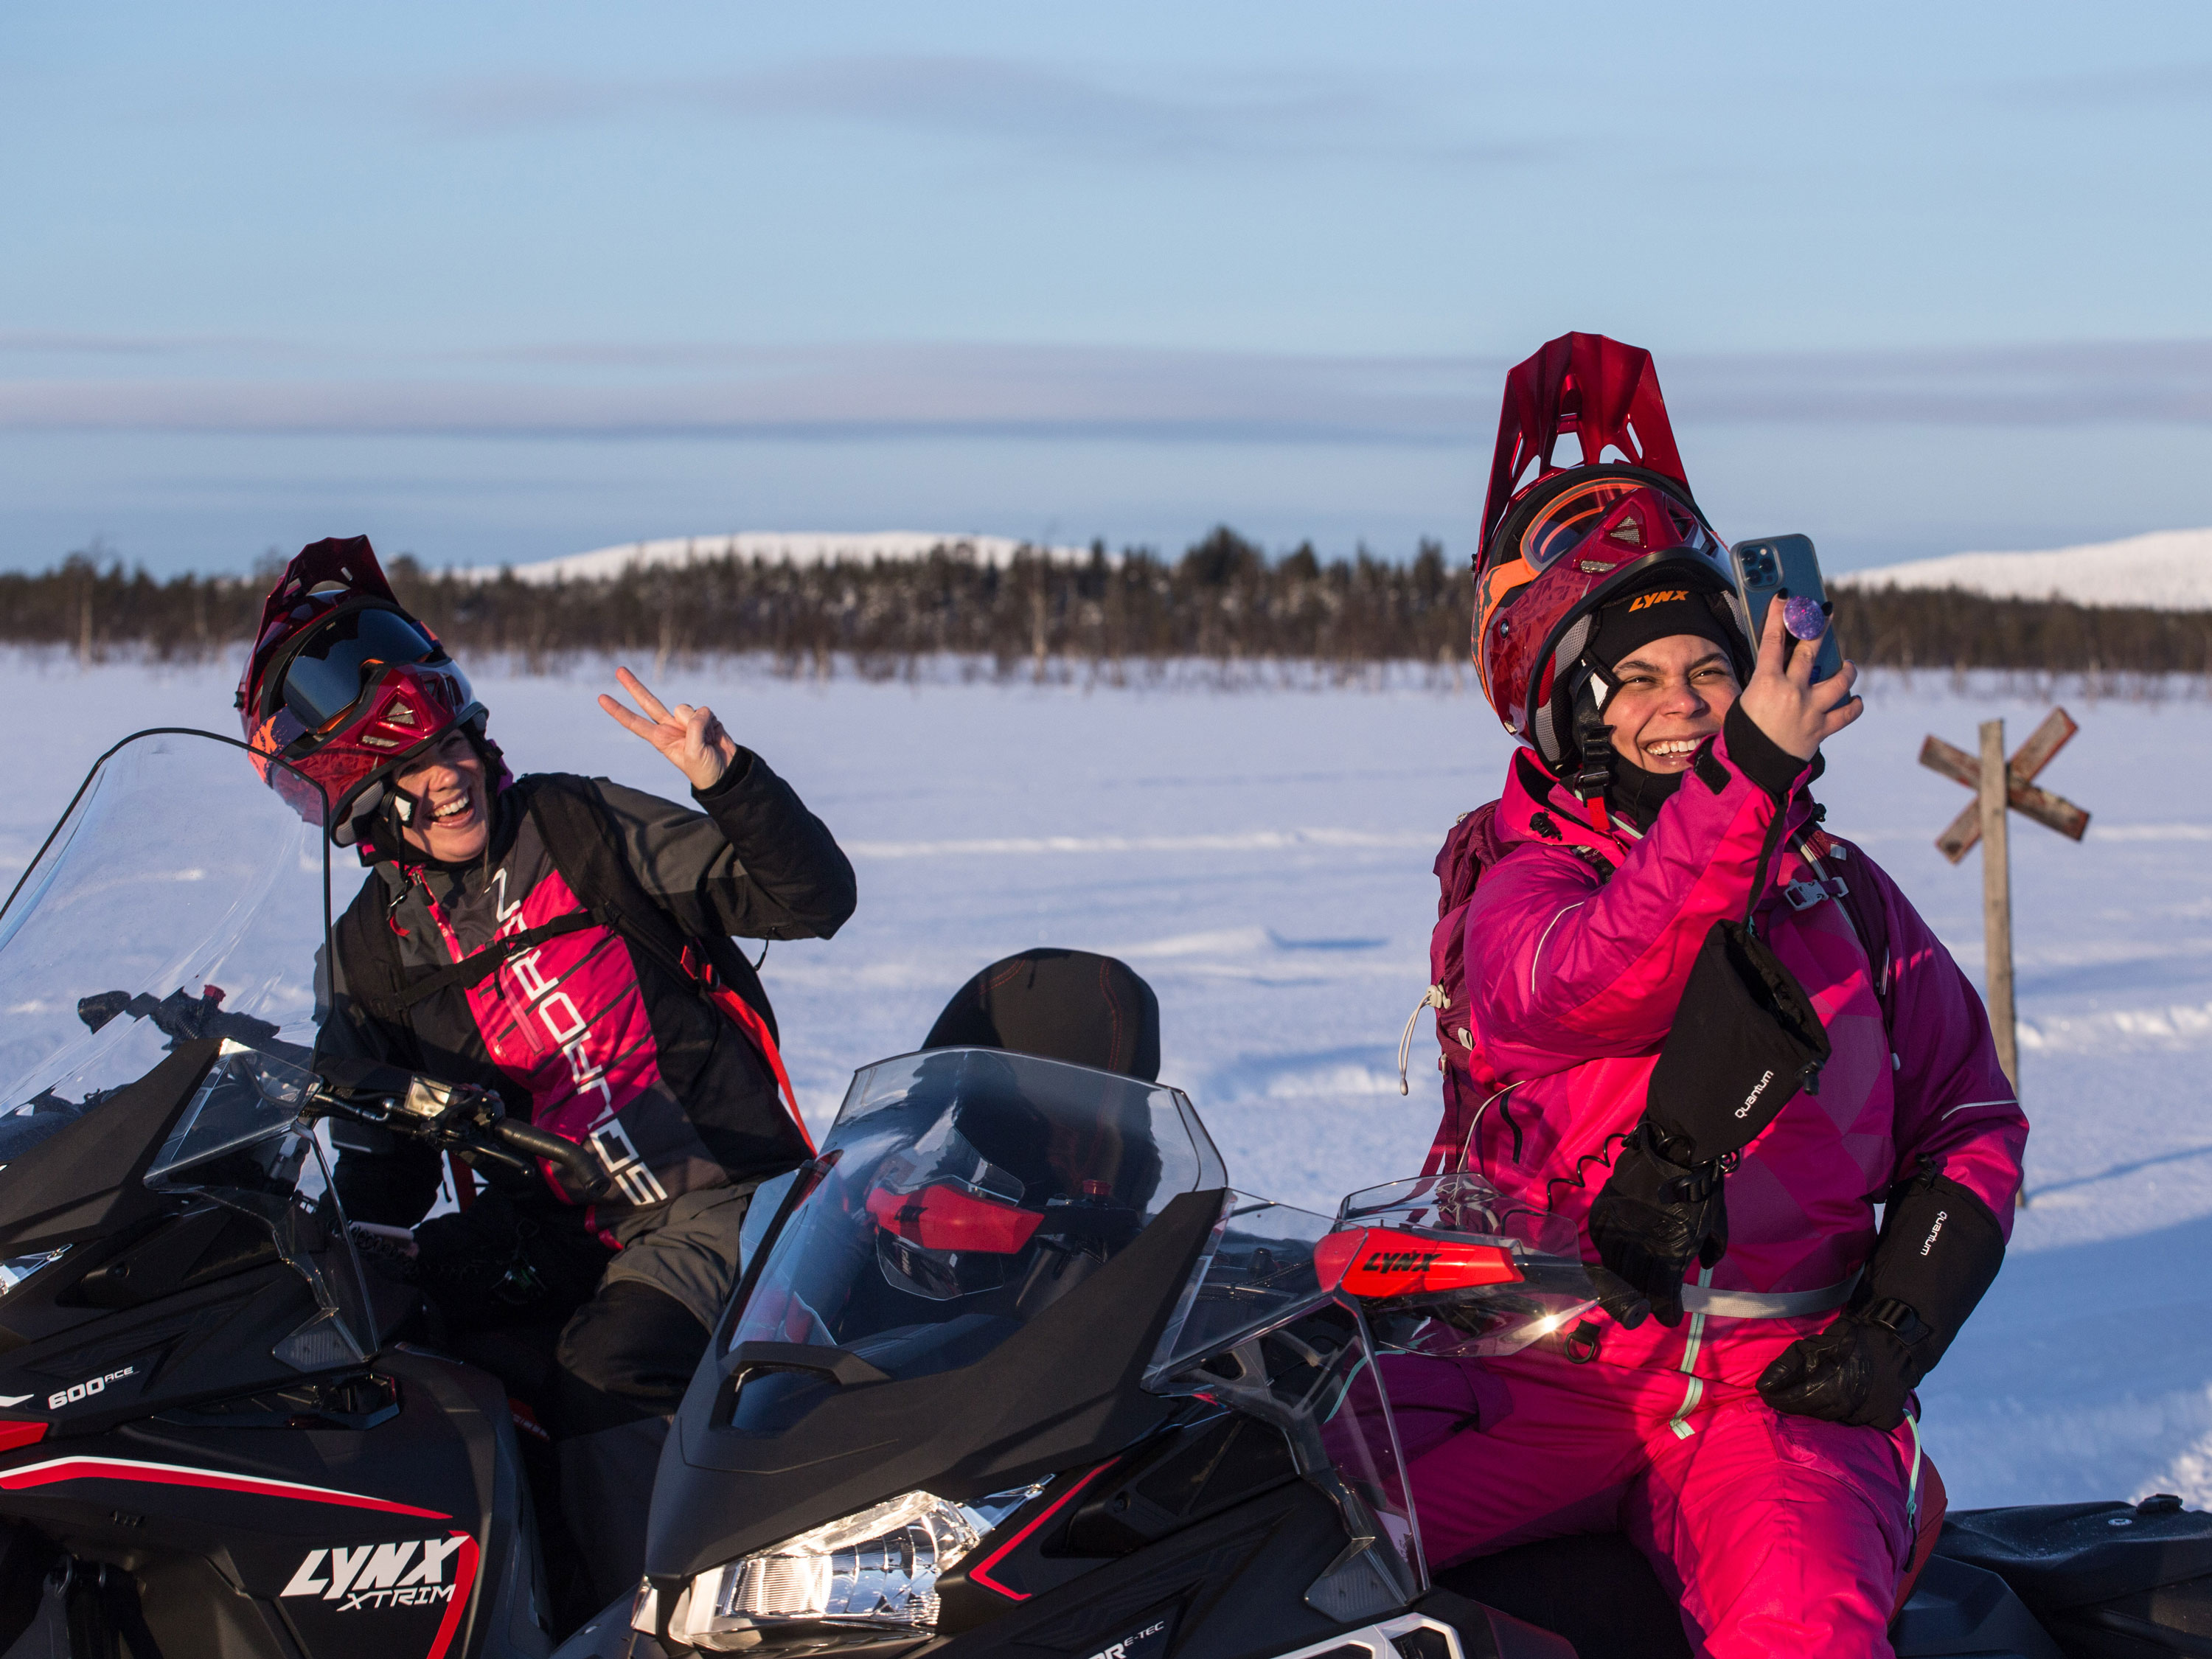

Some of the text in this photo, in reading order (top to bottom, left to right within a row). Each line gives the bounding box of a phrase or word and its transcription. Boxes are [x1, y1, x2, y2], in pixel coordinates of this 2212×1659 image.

[1629, 590, 1689, 612] LYNX
[1734, 1070, 1774, 1119] Quantum
[1920, 1211, 1947, 1256] Quantum
[1363, 1252, 1442, 1274] LYNX
[279, 1535, 470, 1599] LYNX
[336, 1584, 456, 1612] XTRIM
[1088, 1621, 1164, 1659] R E-TEC
